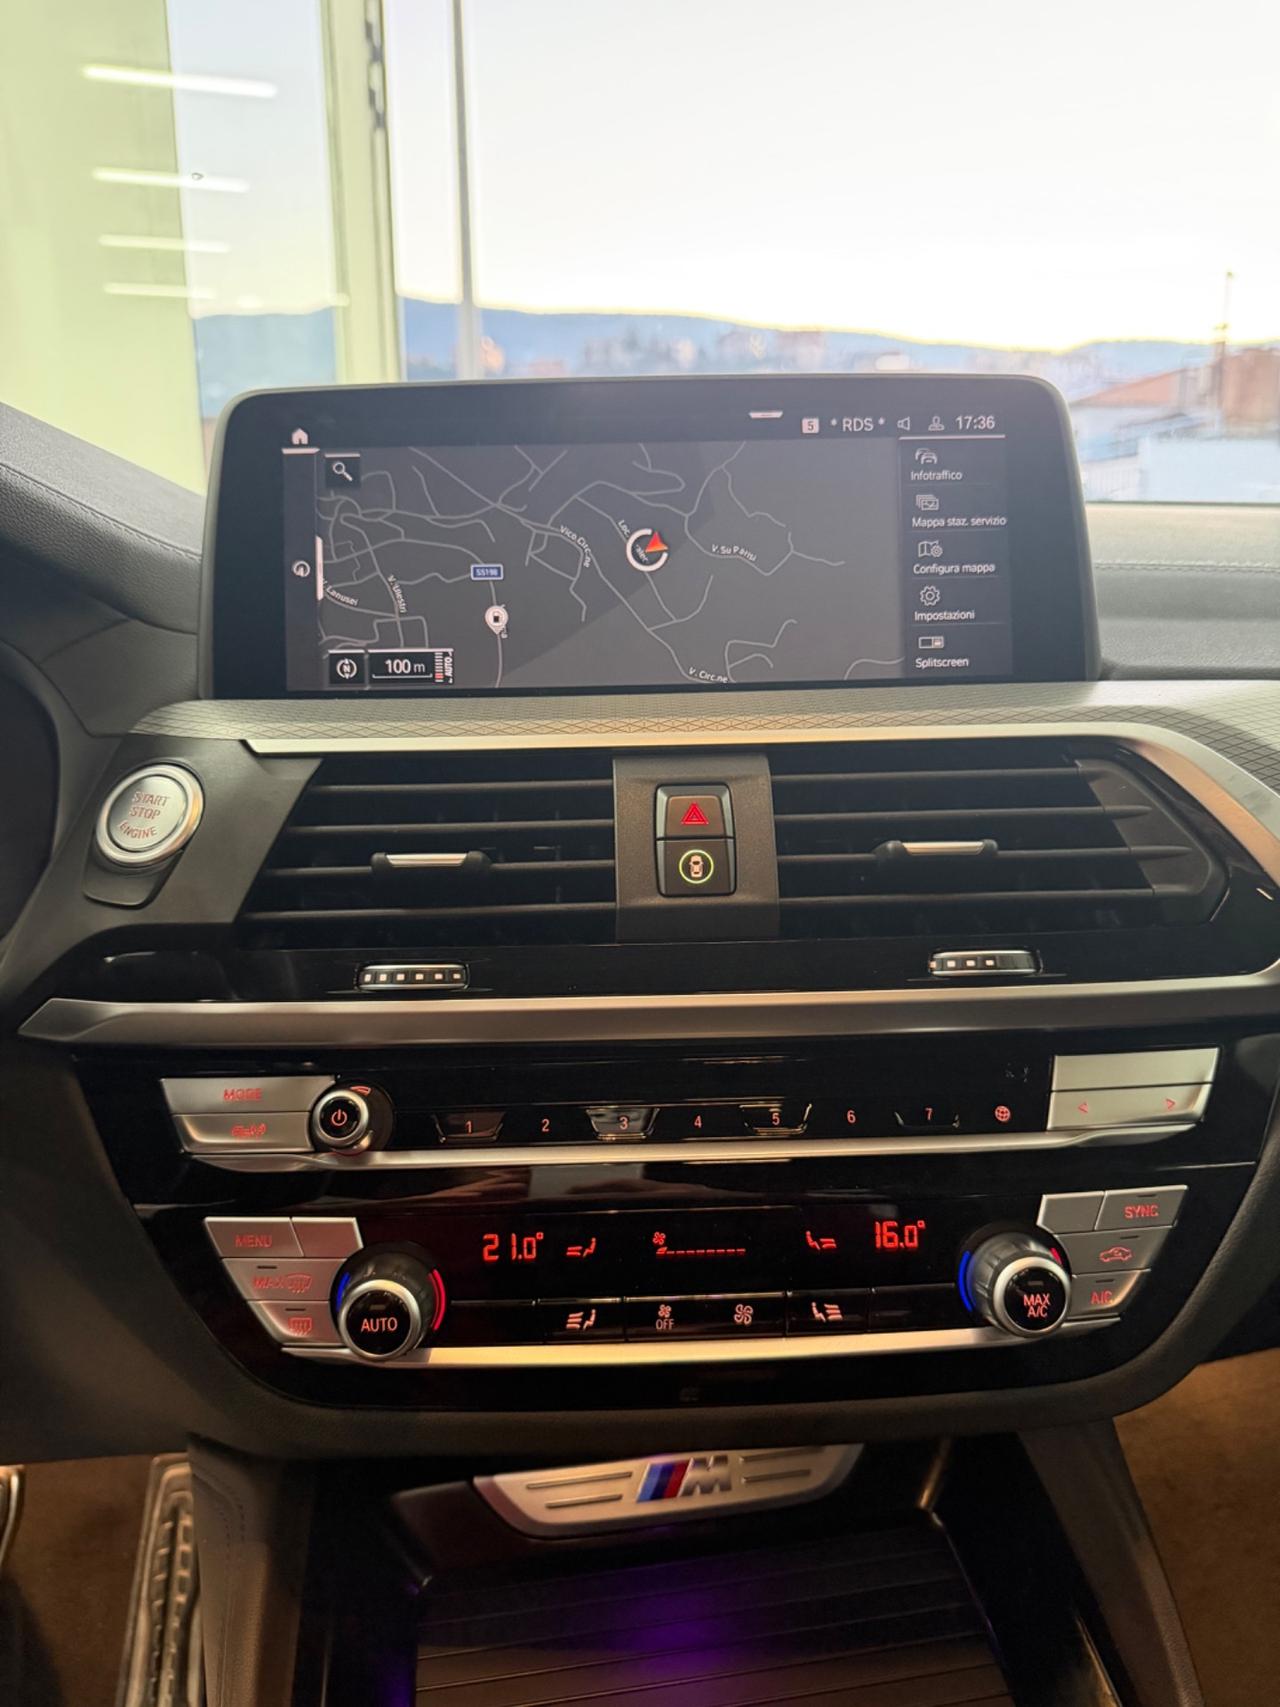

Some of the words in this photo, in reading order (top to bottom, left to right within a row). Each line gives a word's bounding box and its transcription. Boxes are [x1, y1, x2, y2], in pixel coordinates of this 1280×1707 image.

[806, 420, 814, 431] 5
[842, 418, 874, 432] RDS
[955, 415, 996, 430] 17:36
[910, 470, 963, 481] Infotraffico
[912, 517, 945, 528] Mappa
[946, 517, 969, 527] staz.
[970, 516, 1008, 526] servizio
[560, 525, 578, 541] Vico
[913, 563, 960, 575] Configura
[962, 563, 996, 574] mappa
[914, 610, 975, 622] Impostazioni
[385, 659, 411, 674] 100
[413, 663, 425, 673] m
[444, 656, 453, 677] AUTO
[915, 657, 969, 669] Splitscreen
[133, 791, 168, 807] START
[130, 806, 160, 820] STOP
[119, 820, 157, 839] ENGINE
[465, 1120, 472, 1133] 1
[541, 1119, 549, 1132] 2
[619, 1117, 628, 1130] 3
[694, 1115, 702, 1129] 4
[772, 1113, 780, 1126] 5
[847, 1110, 855, 1123] 6
[925, 1108, 933, 1121] 7
[1124, 1203, 1159, 1219] SYNC
[234, 1235, 273, 1248] MENU
[1023, 1293, 1050, 1307] MAX
[1027, 1306, 1048, 1318] A/C
[361, 1318, 398, 1332] AUTO
[656, 1319, 674, 1330] OFF
